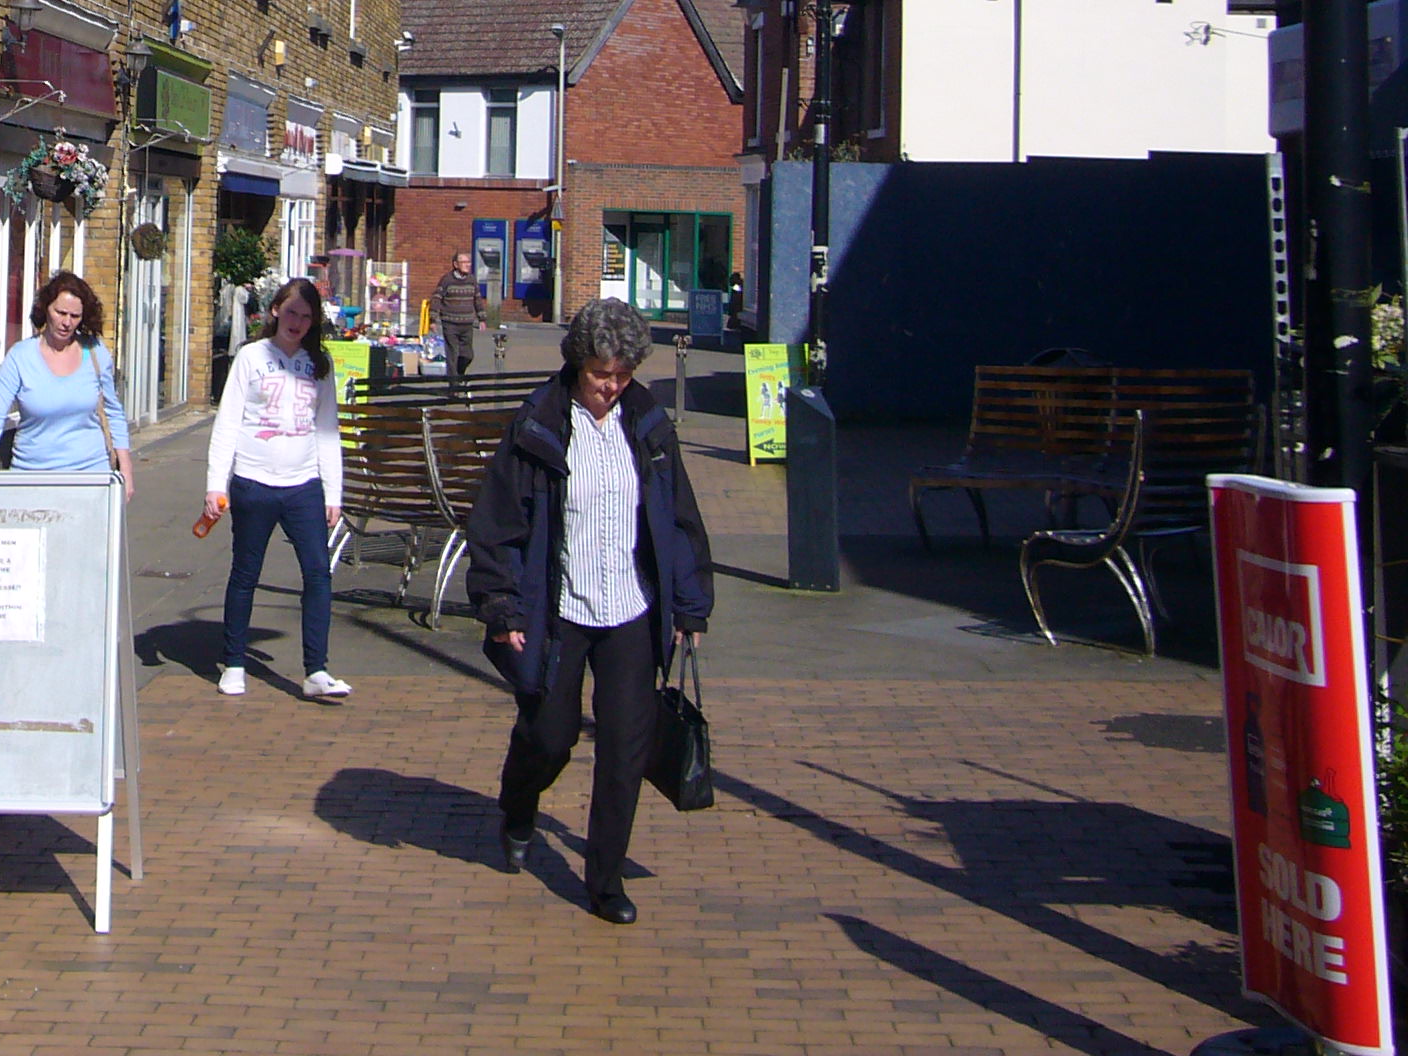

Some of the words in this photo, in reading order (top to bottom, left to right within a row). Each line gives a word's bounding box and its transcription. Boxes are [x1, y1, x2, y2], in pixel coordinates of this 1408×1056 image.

[260, 376, 316, 417] 75
[1246, 606, 1310, 676] CALOR
[1258, 842, 1342, 922] SOLD
[1261, 897, 1348, 985] HERE
